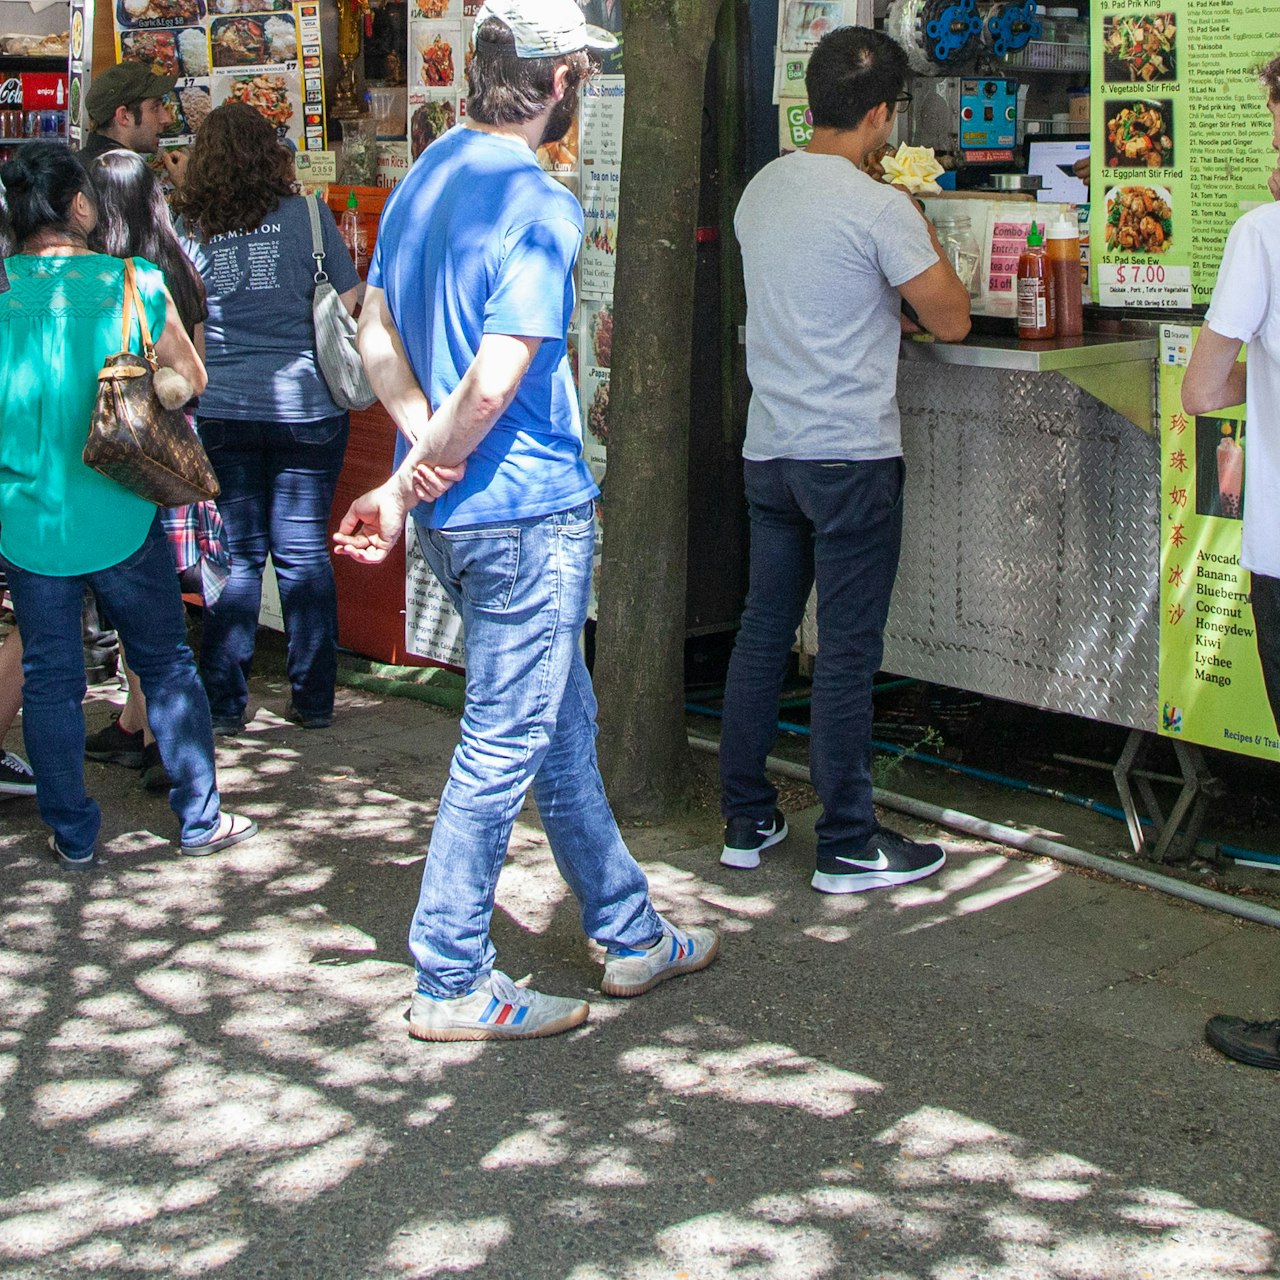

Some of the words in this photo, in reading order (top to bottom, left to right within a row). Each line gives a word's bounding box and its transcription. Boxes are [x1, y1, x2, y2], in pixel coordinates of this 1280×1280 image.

[1101, 1, 1110, 9] 19.
[1113, 0, 1124, 8] Pad
[1127, 0, 1141, 8] Prik
[184, 78, 195, 87] $7
[37, 88, 54, 96] enjoy
[1101, 85, 1107, 93] 9.
[1109, 84, 1144, 95] Vegetable
[1147, 84, 1159, 92] Stir
[1162, 84, 1180, 92] Fried
[1102, 170, 1111, 178] 12.
[1113, 170, 1146, 180] Eggplant
[1149, 170, 1161, 178] Stir
[1163, 170, 1182, 178] Fried
[993, 227, 1023, 236] Combo
[1102, 256, 1111, 264] 15.
[1115, 256, 1128, 264] Pad
[1148, 257, 1159, 265] Ew
[991, 263, 1003, 271] tea
[1004, 263, 1013, 271] or
[1117, 264, 1125, 284] $
[1132, 265, 1165, 283] 7.00
[1001, 279, 1011, 288] off
[1196, 566, 1237, 583] Banana
[1196, 584, 1250, 605] Blueberry
[1196, 601, 1242, 618] Coconut
[1196, 617, 1254, 638] Honeydew
[1195, 635, 1221, 649] Kiwi
[1195, 652, 1232, 669] Lychee
[1195, 669, 1231, 687] Mango
[1223, 728, 1253, 744] Recipes
[1255, 732, 1262, 744] &
